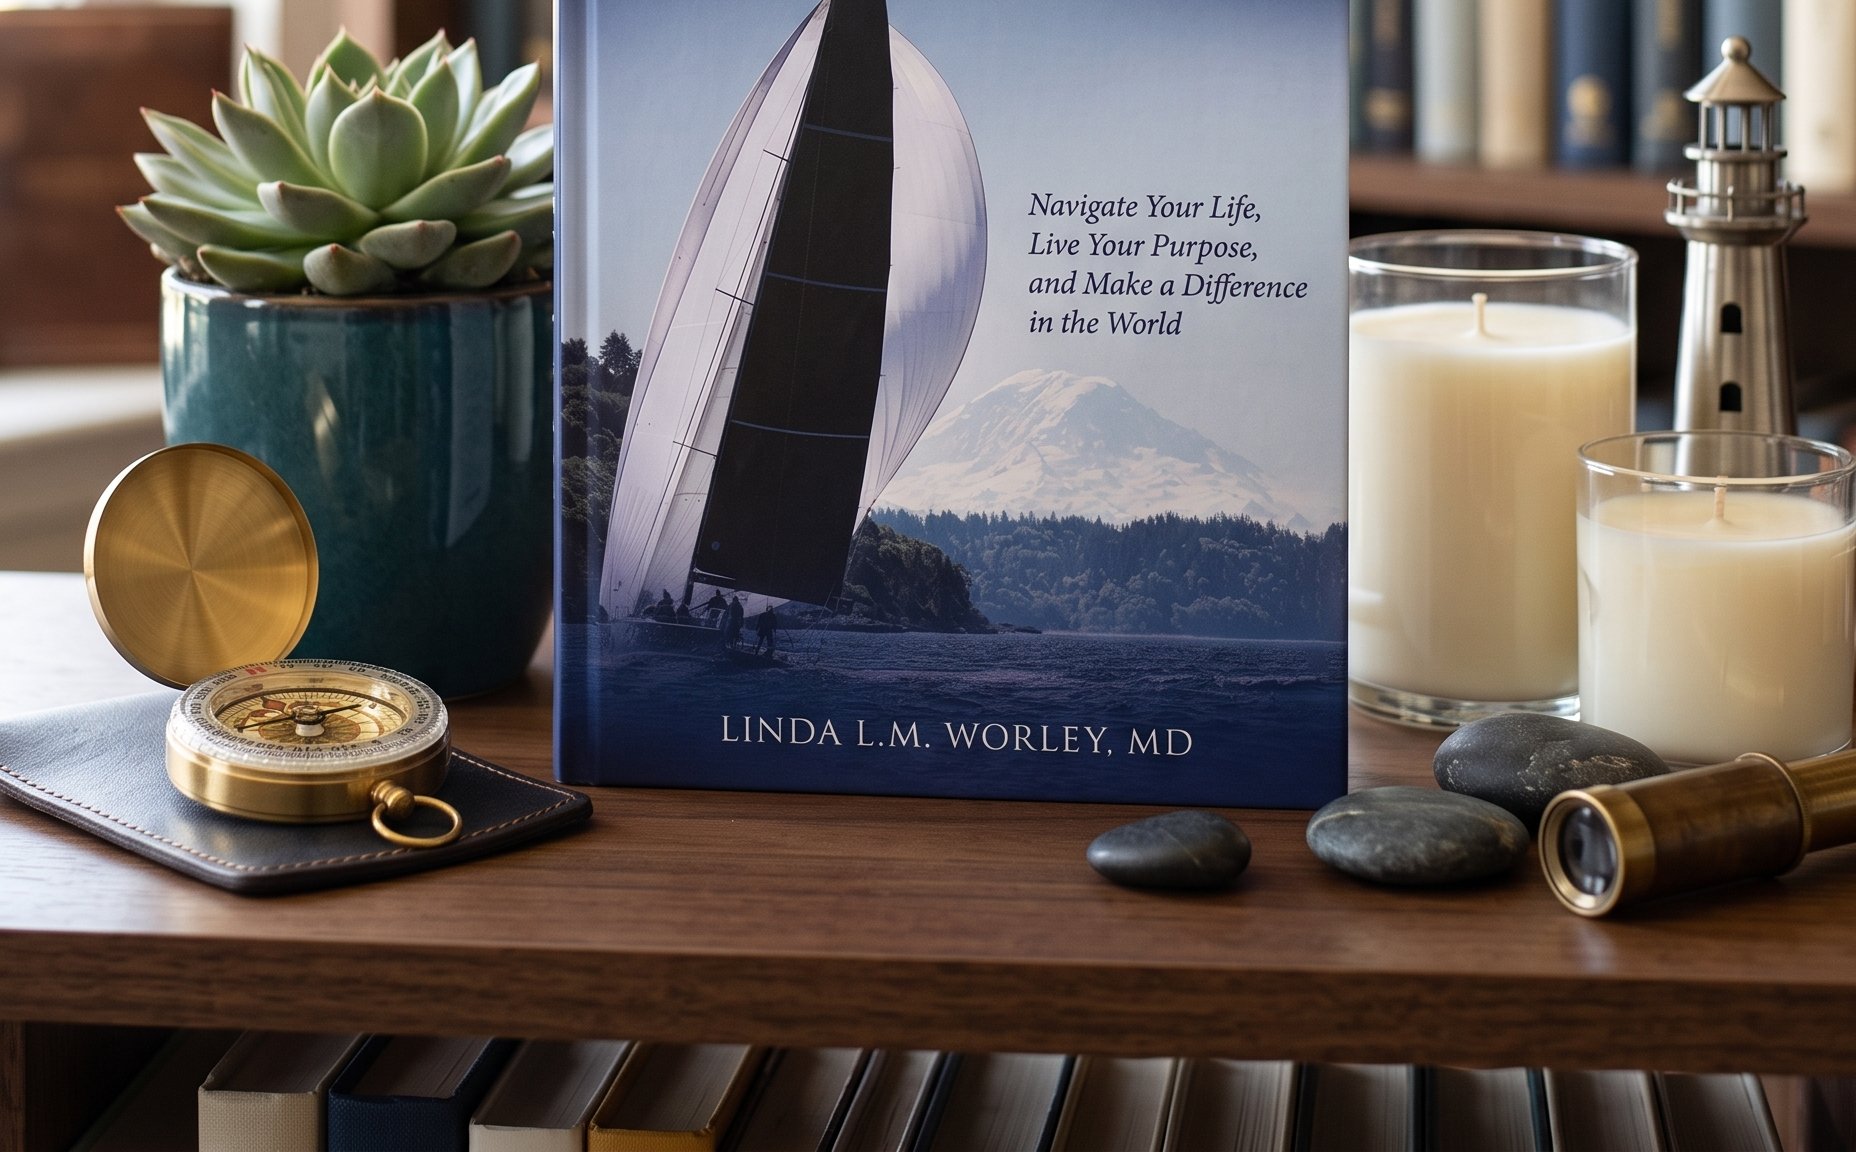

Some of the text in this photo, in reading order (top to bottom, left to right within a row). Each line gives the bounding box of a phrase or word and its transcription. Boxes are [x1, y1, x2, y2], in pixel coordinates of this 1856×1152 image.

[1027, 192, 1261, 227] Navigate Your Life,
[1027, 231, 1258, 266] Live Your Purpose,
[1028, 269, 1308, 305] and Make a Difference
[1029, 308, 1183, 336] in the World
[722, 715, 1192, 757] LINDA L.M. WORLEY, MD
